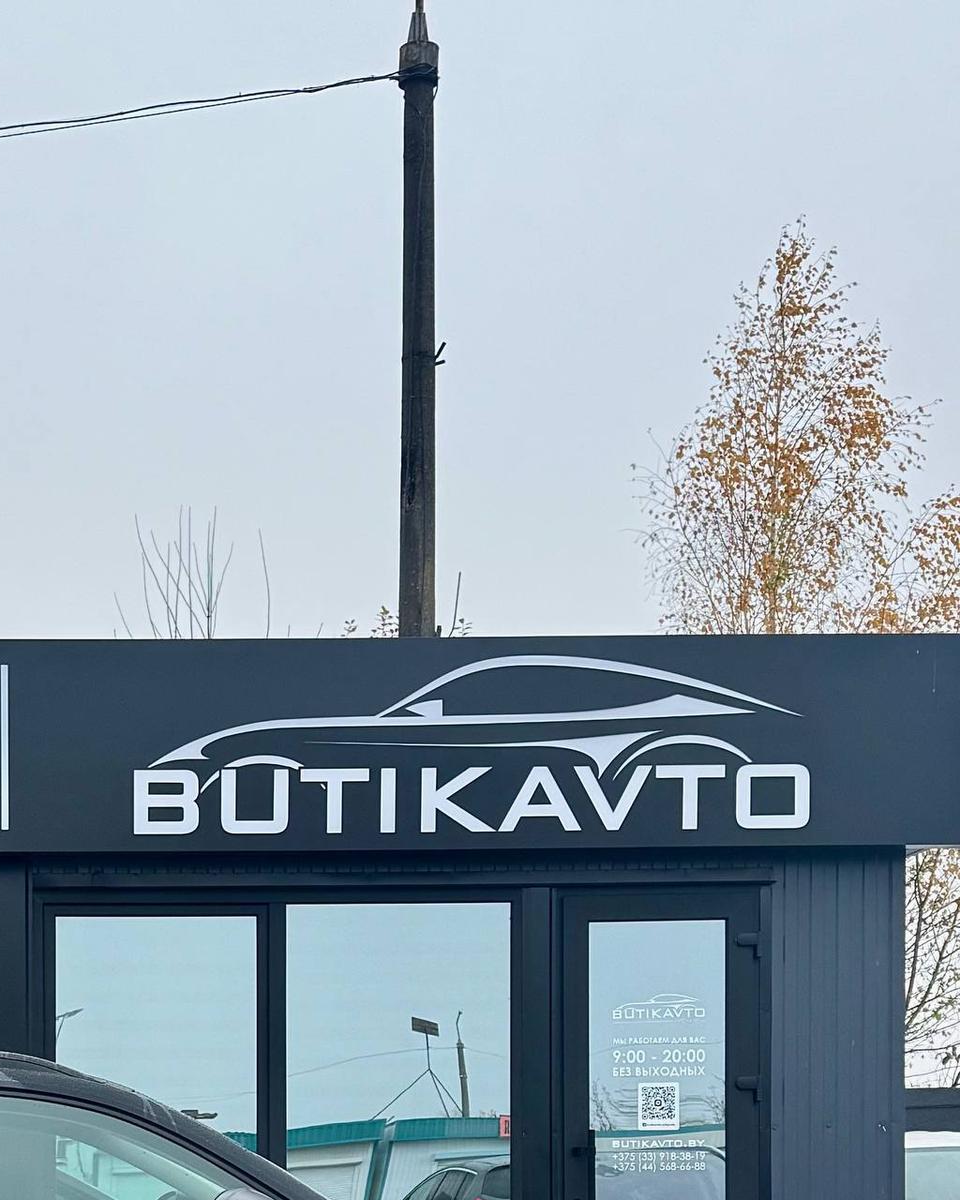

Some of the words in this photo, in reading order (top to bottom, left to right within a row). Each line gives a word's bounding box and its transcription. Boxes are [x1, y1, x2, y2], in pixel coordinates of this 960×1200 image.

[133, 763, 810, 835] BUTIKAVTO
[612, 1008, 706, 1019] BUTIKAVTO
[612, 1037, 627, 1045] МЫ
[628, 1036, 670, 1044] РАБОТАЕМ
[671, 1036, 688, 1044] ДЛЯ
[689, 1035, 707, 1044] ВАС
[612, 1050, 646, 1064] 9:00
[662, 1049, 706, 1063] 20:00
[612, 1066, 632, 1077] БЕЗ
[635, 1065, 706, 1077] ВЫХОДНЫХ
[612, 1139, 706, 1148] BUTIKAVTO.BY
[612, 1152, 636, 1161] +375
[638, 1151, 657, 1163] (33)
[660, 1151, 706, 1161] 918-38-19
[612, 1162, 636, 1171] +375
[638, 1162, 657, 1173] (44)
[660, 1162, 706, 1171] 568-66-88
